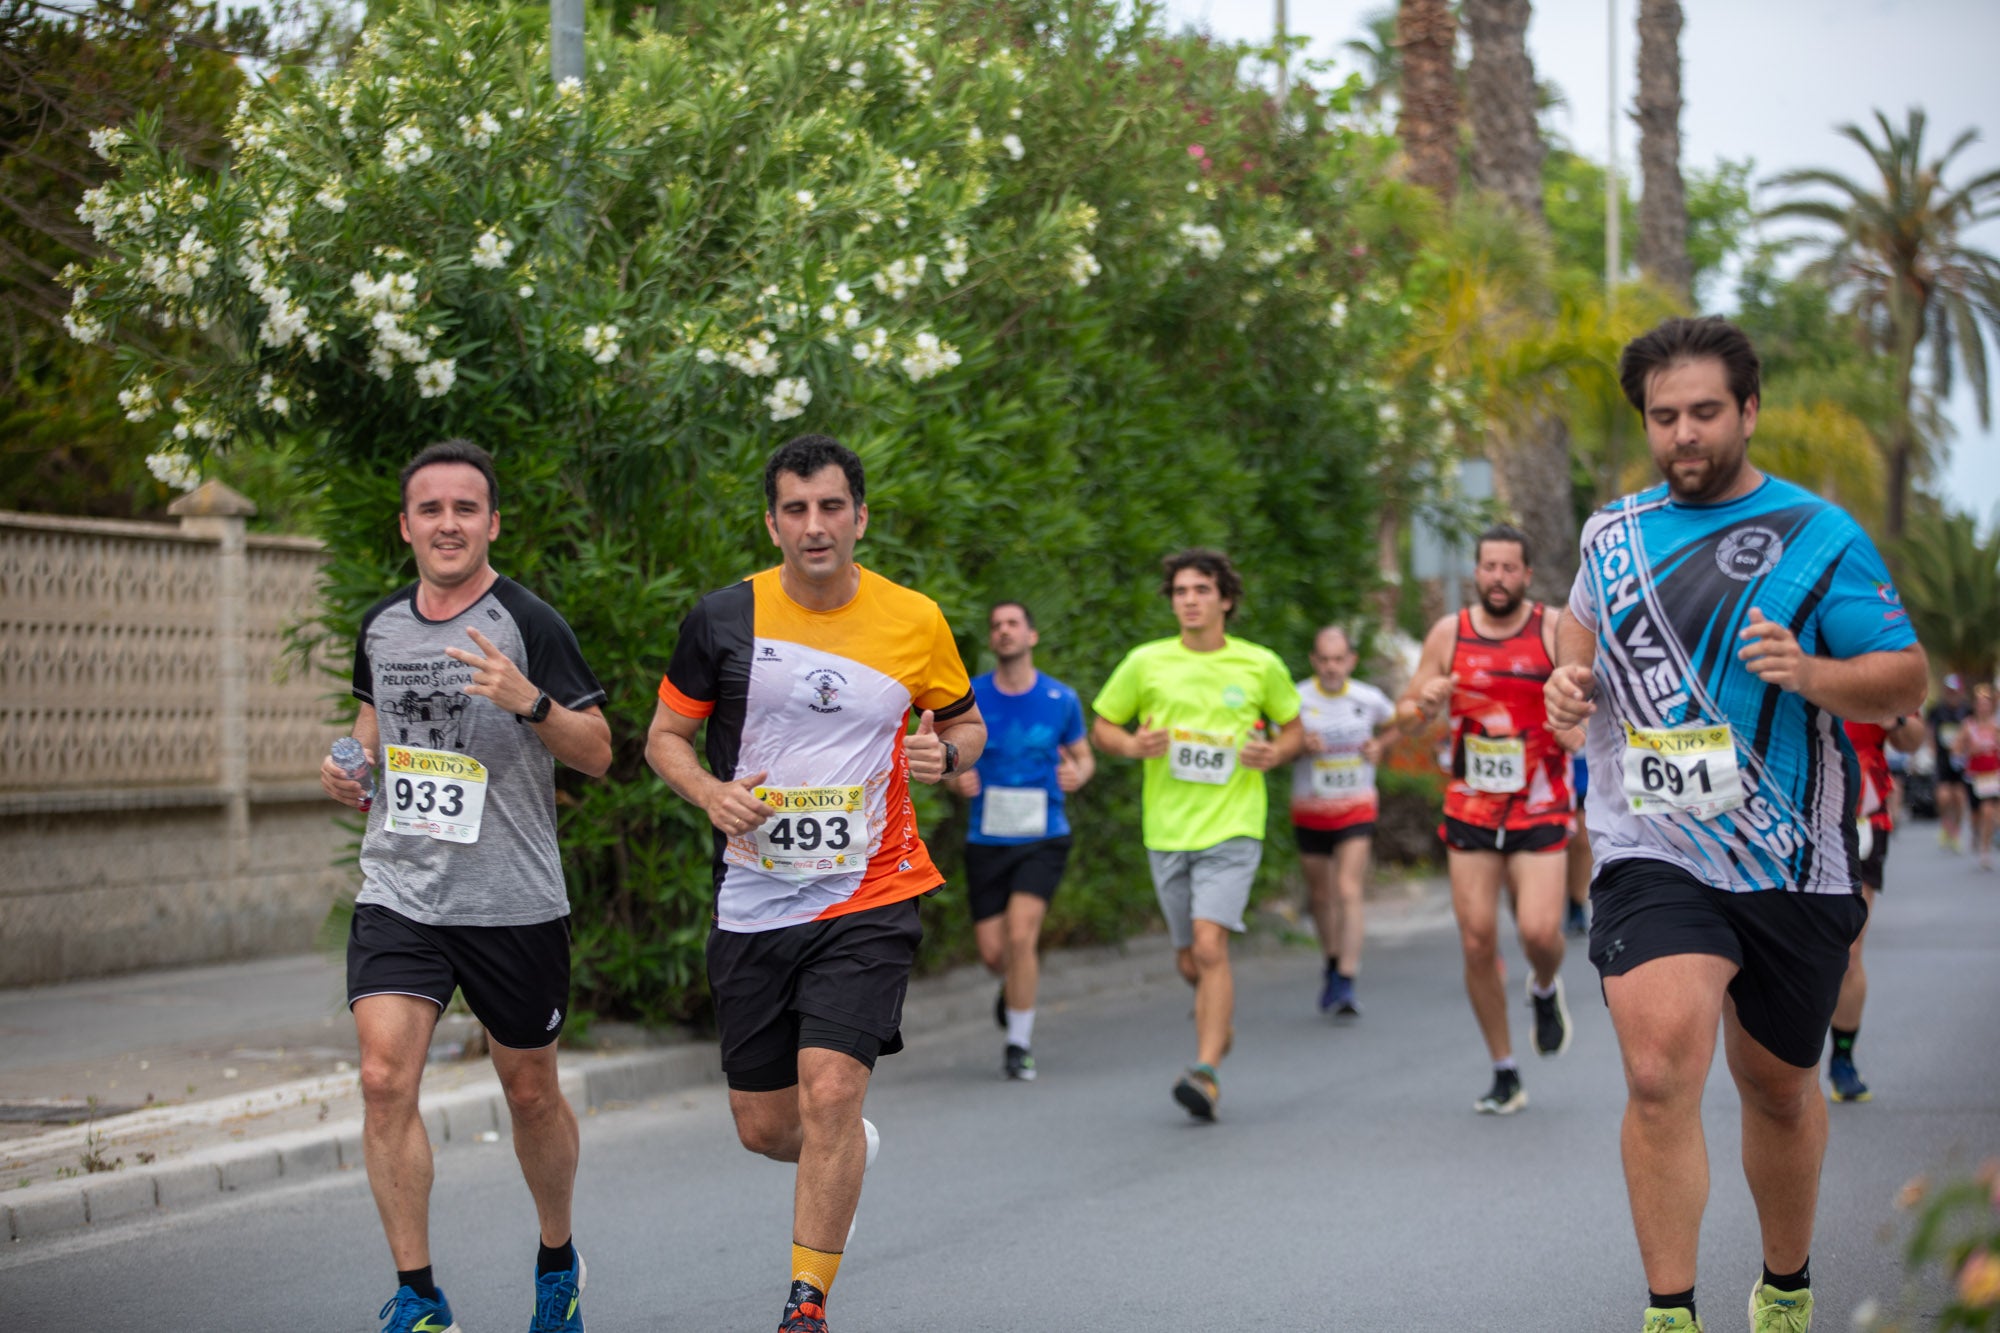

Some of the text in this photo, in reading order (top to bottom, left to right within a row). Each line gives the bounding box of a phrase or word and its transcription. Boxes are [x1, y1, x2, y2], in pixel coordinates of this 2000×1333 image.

[384, 662, 429, 671] CARRERA
[431, 661, 446, 671] DE
[808, 703, 842, 714] PELIGROS
[1641, 756, 1713, 796] 691
[395, 778, 464, 817] 933
[769, 816, 851, 851] 493
